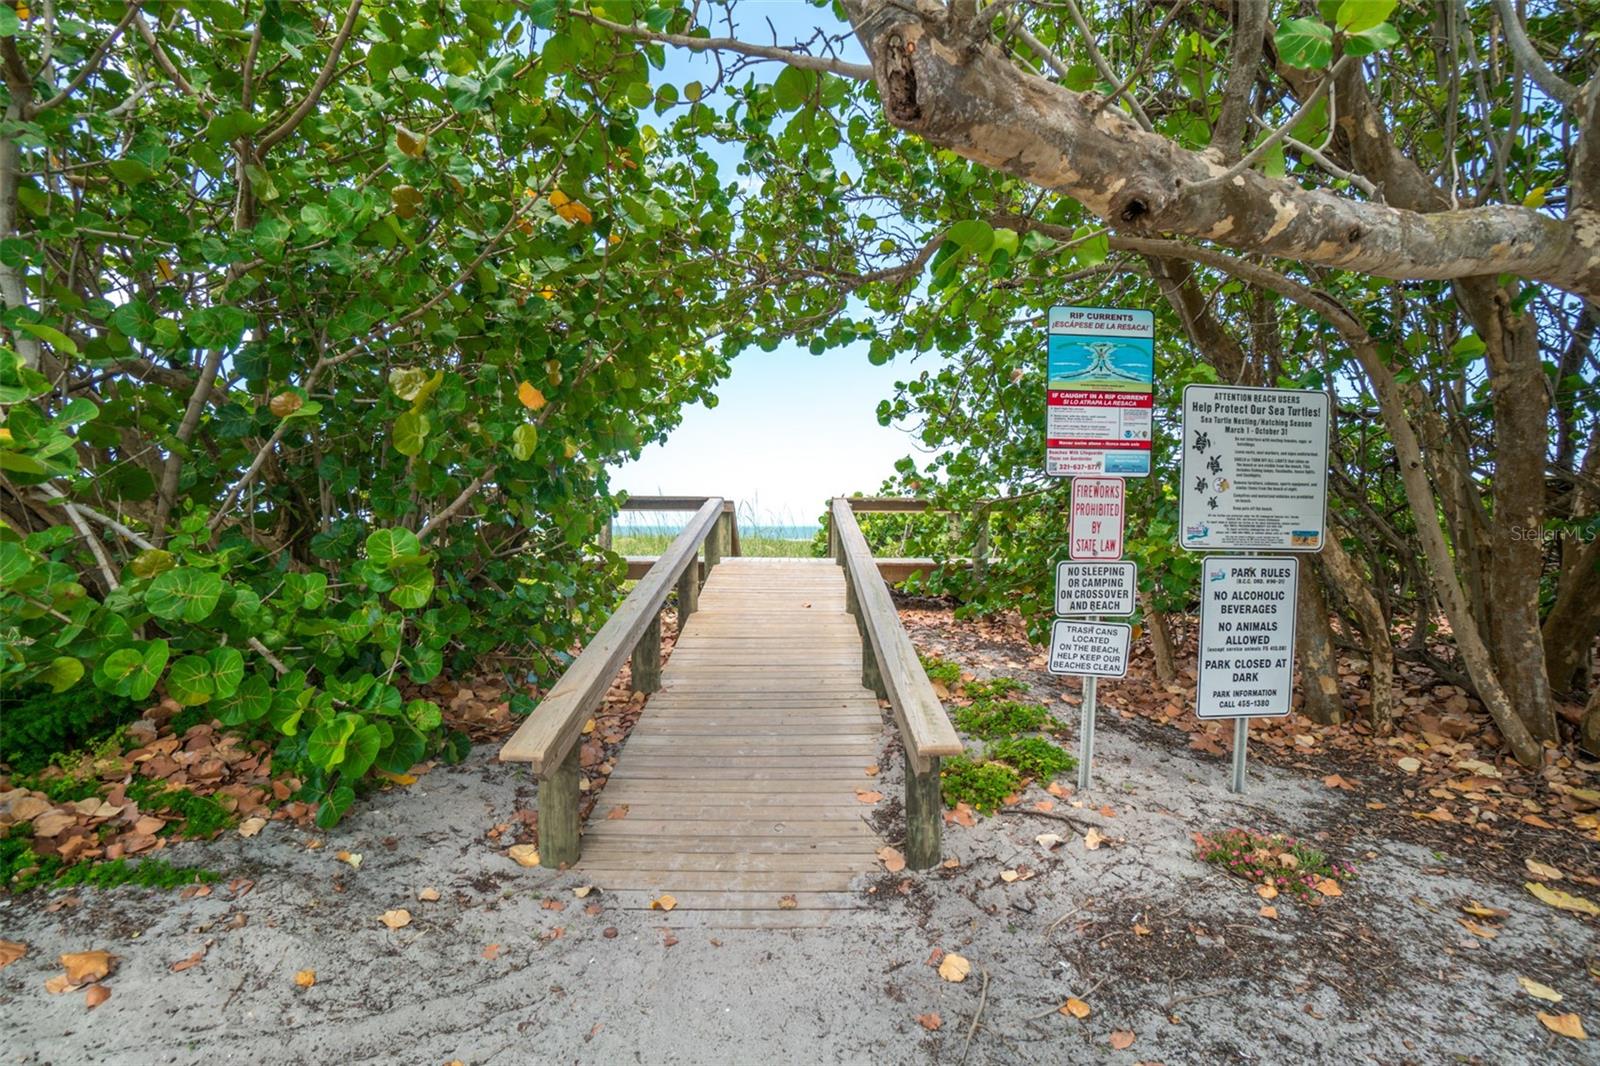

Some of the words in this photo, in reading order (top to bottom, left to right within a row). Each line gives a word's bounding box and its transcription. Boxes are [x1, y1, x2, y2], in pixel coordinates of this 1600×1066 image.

[1087, 313, 1133, 321] CURRENTS
[1052, 321, 1093, 329] ¡ESCÁPESE
[1214, 392, 1252, 401] ATTENTION
[1254, 394, 1276, 402] BEACH
[1278, 396, 1300, 404] USERS
[1192, 402, 1212, 413] Help
[1215, 403, 1248, 414] Protect
[1251, 405, 1264, 415] Our
[1268, 405, 1285, 416] Sea
[1288, 406, 1321, 417] Turtles!
[1234, 417, 1288, 427] Nesting/Hatching
[1077, 485, 1119, 498] FIREWORKS
[1076, 503, 1119, 516] PROHIBITED
[1092, 521, 1101, 534] BY
[1076, 539, 1096, 552] STATE
[1100, 540, 1116, 552] LAW
[1068, 567, 1080, 576] NO
[1082, 567, 1125, 576] SLEEPING
[1231, 568, 1256, 577] PARK
[1261, 568, 1291, 578] RULES
[1068, 579, 1080, 588] OR
[1082, 578, 1123, 587] CAMPING
[1061, 590, 1072, 599] ON
[1075, 590, 1128, 599] CROSSOVER
[1214, 591, 1228, 600] NO
[1232, 591, 1285, 600] ALCOHOLIC
[1070, 601, 1088, 610] AND
[1090, 601, 1120, 610] BEACH
[1221, 605, 1277, 614] BEVERAGES
[1218, 622, 1232, 631] NO
[1236, 622, 1278, 631] ANIMALS
[1226, 636, 1270, 645] ALLOWED
[1090, 645, 1120, 654] BEACH.
[1053, 661, 1091, 669] BEACHES
[1093, 663, 1121, 671] CLEAN.
[1205, 660, 1231, 669] PARK
[1235, 659, 1271, 668] CLOSED
[1275, 659, 1287, 668] AT
[1232, 673, 1258, 682] DARK
